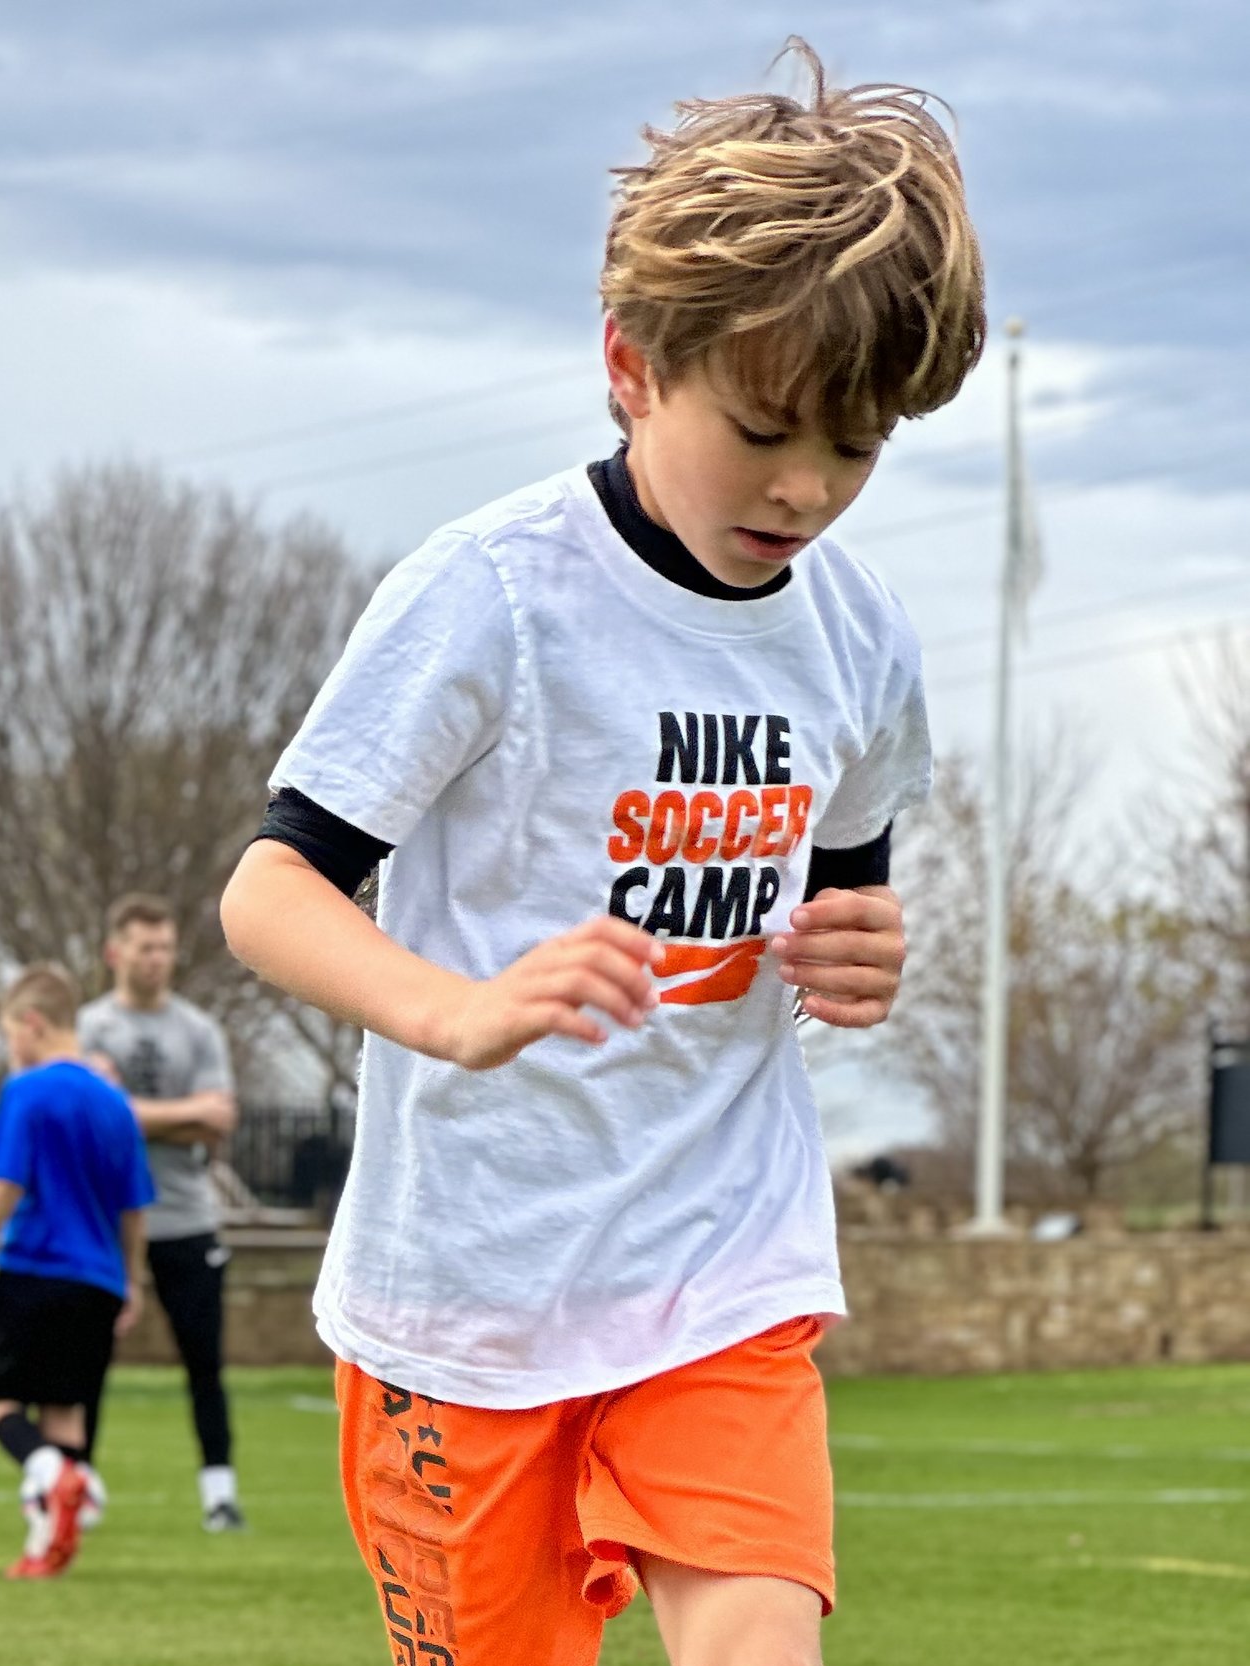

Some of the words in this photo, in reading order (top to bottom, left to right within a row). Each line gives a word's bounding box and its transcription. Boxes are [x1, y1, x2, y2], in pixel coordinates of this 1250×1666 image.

[654, 711, 791, 785] NIKE
[607, 784, 813, 866] SOCCER
[607, 865, 780, 940] CAMP
